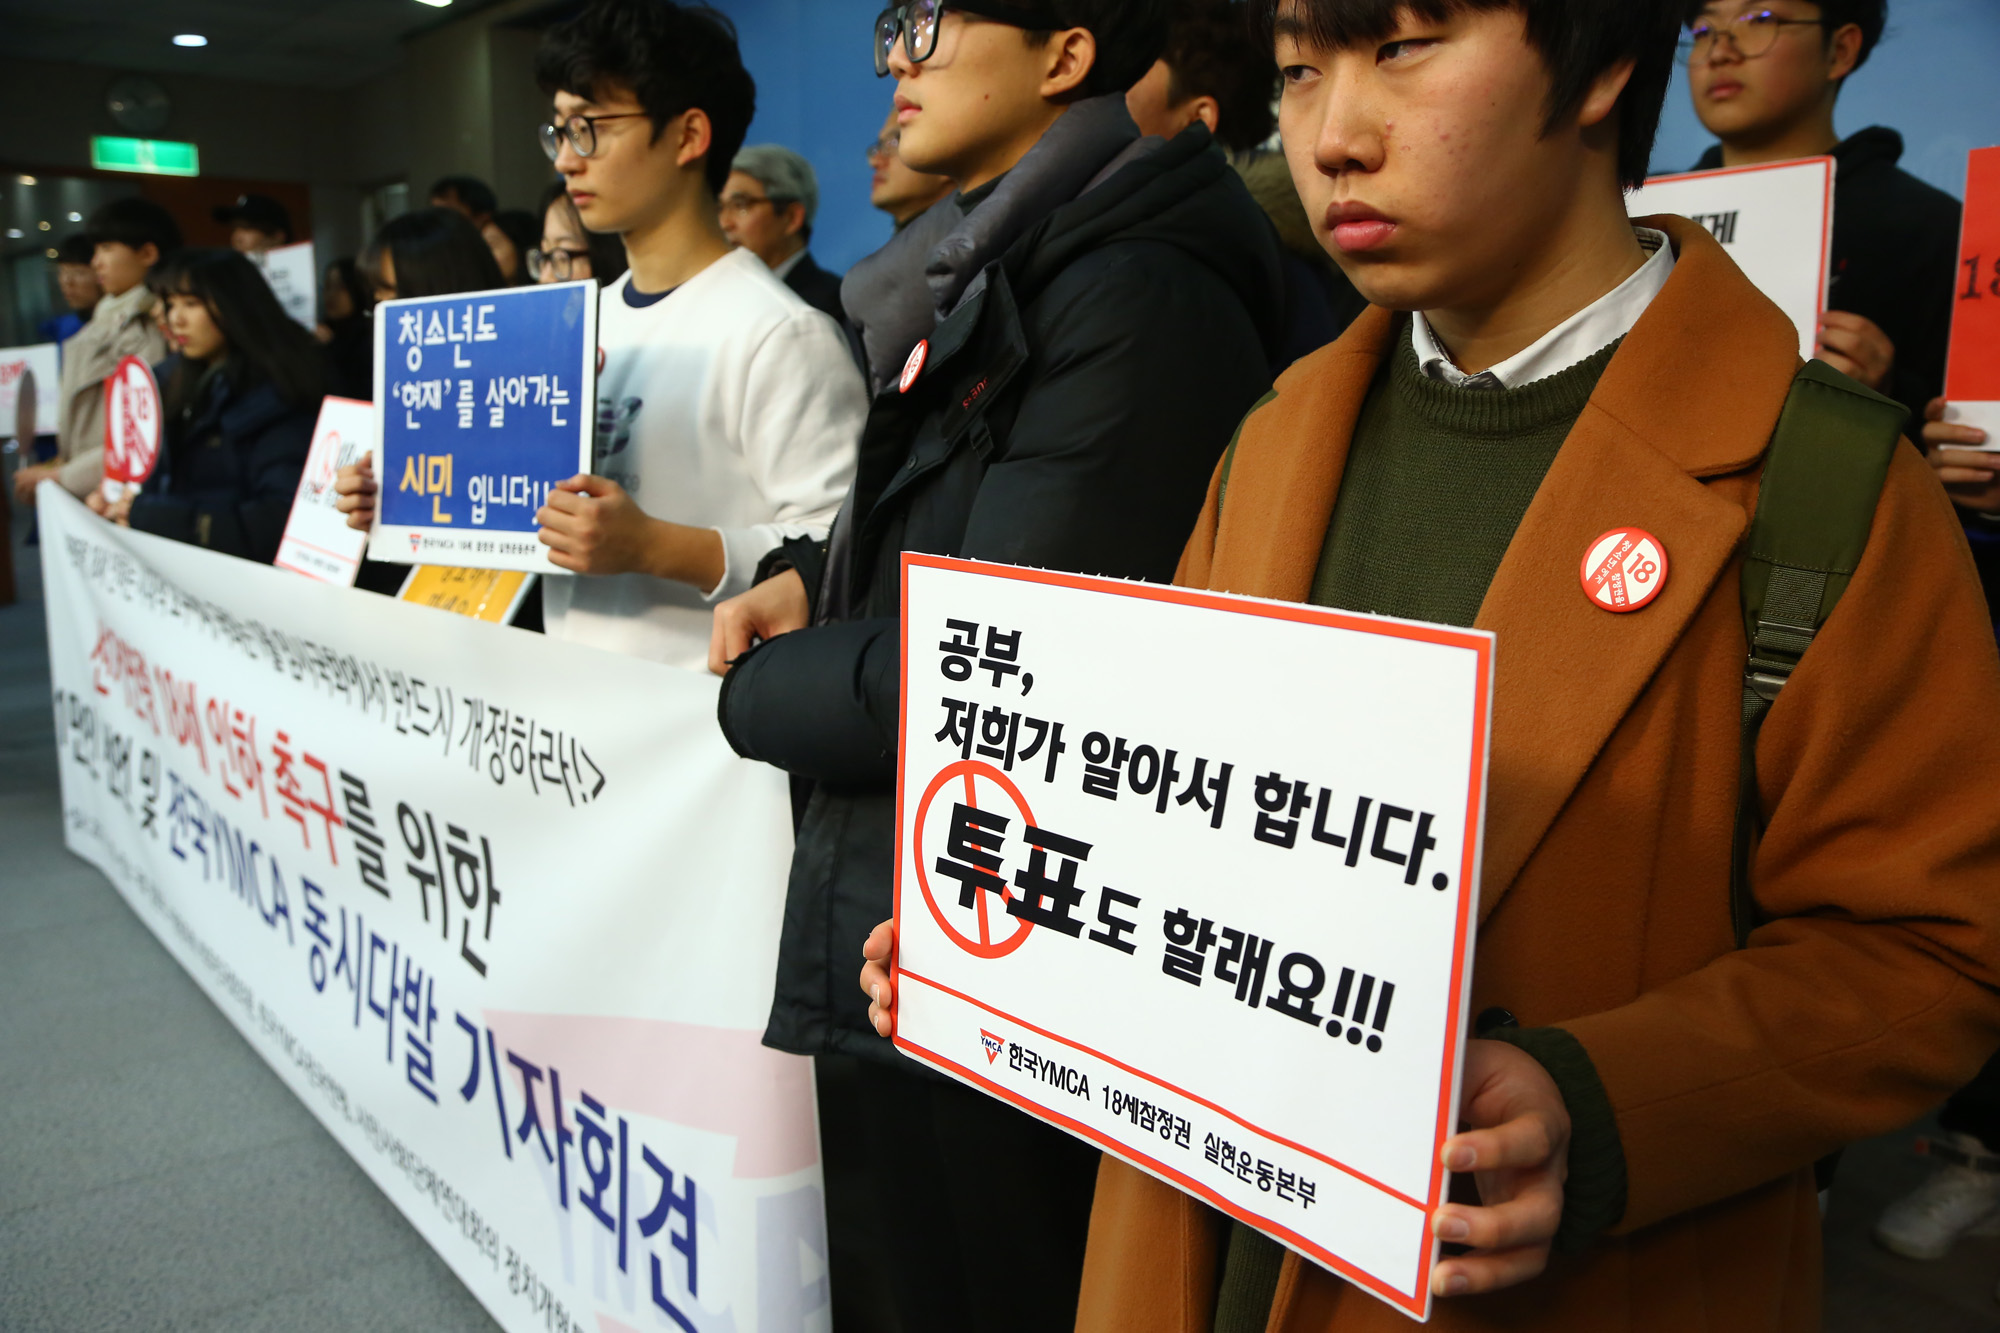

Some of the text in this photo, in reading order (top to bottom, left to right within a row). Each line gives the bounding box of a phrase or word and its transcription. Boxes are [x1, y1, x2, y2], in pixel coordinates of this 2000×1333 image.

[398, 304, 498, 372] 청소년도
[485, 373, 571, 428] 살아가는
[399, 453, 453, 524] 시민
[1595, 540, 1632, 584] 청소년에게
[1611, 573, 1626, 607] 참정권을!
[1626, 552, 1657, 583] 18
[938, 618, 1034, 697] 공부,
[384, 667, 454, 757] 반드시
[460, 697, 606, 808] 개정하라!>
[934, 696, 1449, 892] 저희가 알아서 합니다.
[205, 697, 270, 820] 인하
[265, 728, 391, 900] 촉구를
[396, 801, 501, 979] 위한
[935, 803, 1396, 1053] 투표도 할래요!!!
[139, 748, 170, 841] 및
[167, 768, 294, 946] 전국YMCA
[301, 876, 438, 1105] 동시다발
[455, 1010, 700, 1333] 기자회견
[980, 1036, 1003, 1054] YMCA
[1009, 1042, 1317, 1209] 한국YMCA 18세참정권 실현운동본부
